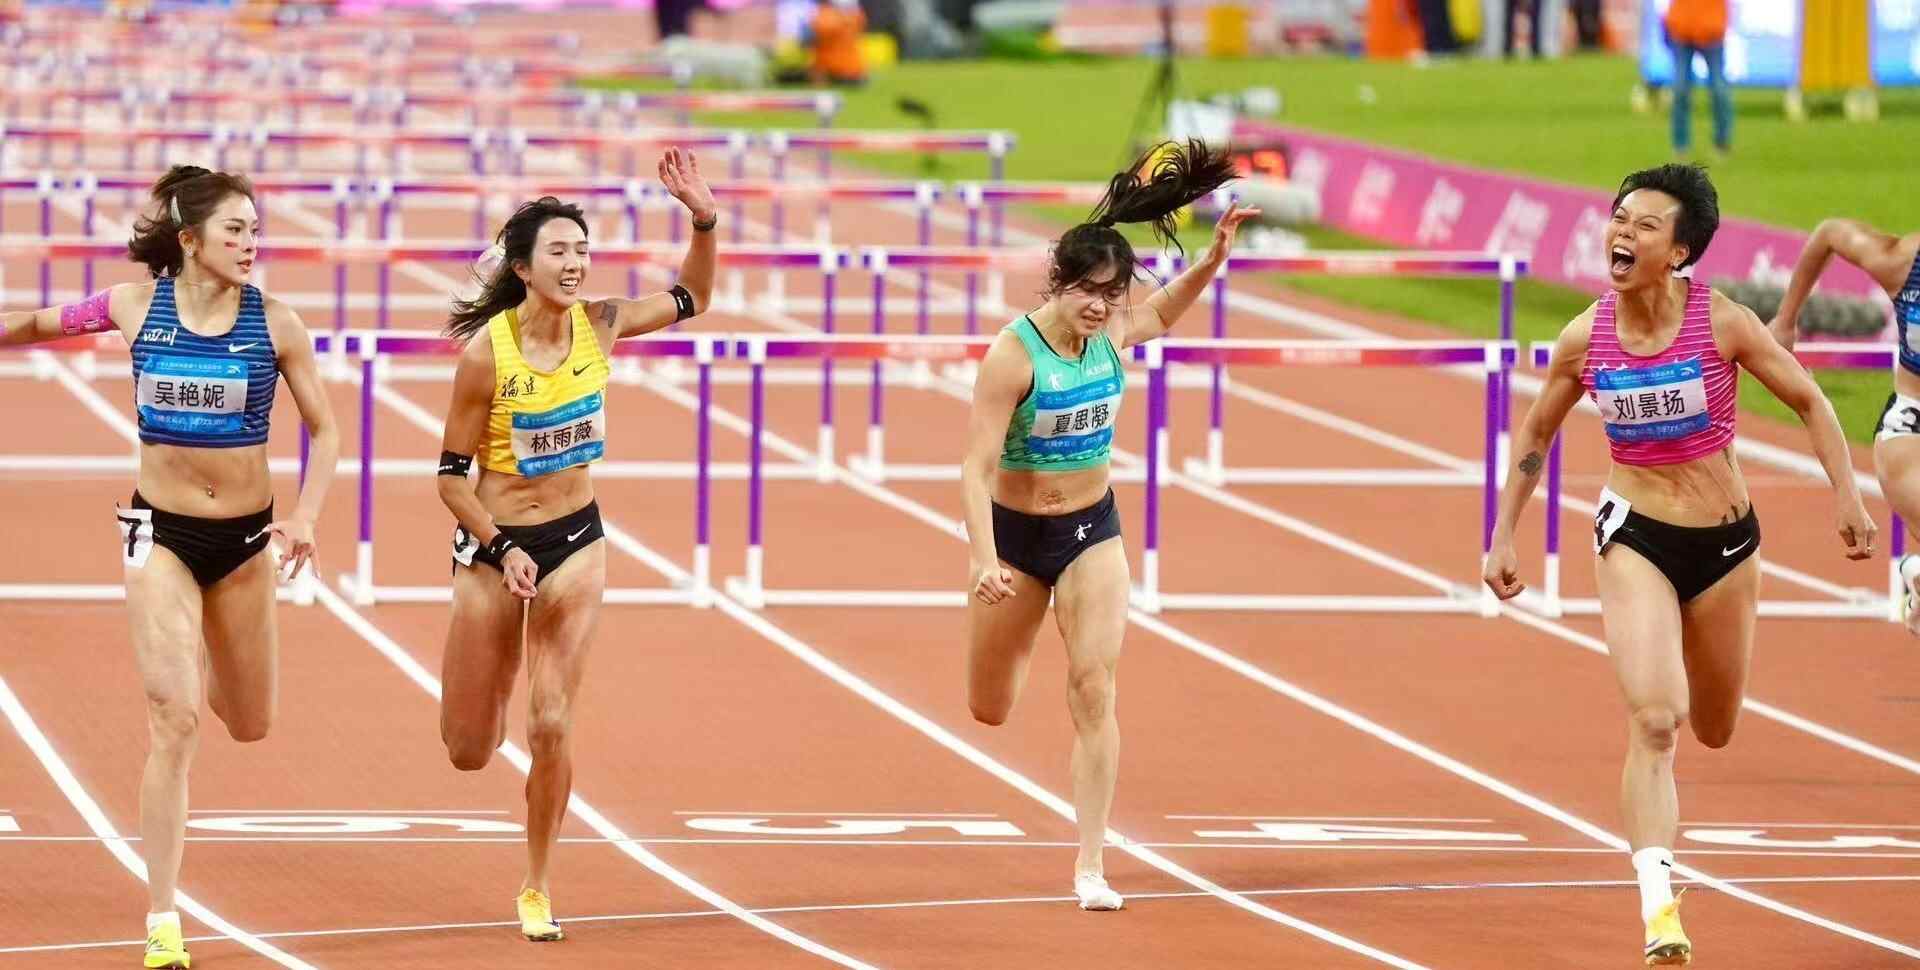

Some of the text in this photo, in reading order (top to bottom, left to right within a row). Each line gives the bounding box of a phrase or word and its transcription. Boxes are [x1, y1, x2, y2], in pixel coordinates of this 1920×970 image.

[154, 380, 226, 409] 吴艳妮
[1612, 389, 1686, 421] 刘景扬
[1051, 403, 1110, 436] 夏思凝
[531, 420, 593, 454] 林雨薇
[117, 514, 143, 558] 7
[1595, 500, 1616, 547] 4
[185, 815, 526, 833] 6
[684, 817, 1026, 837] 5
[1192, 822, 1529, 841] 4
